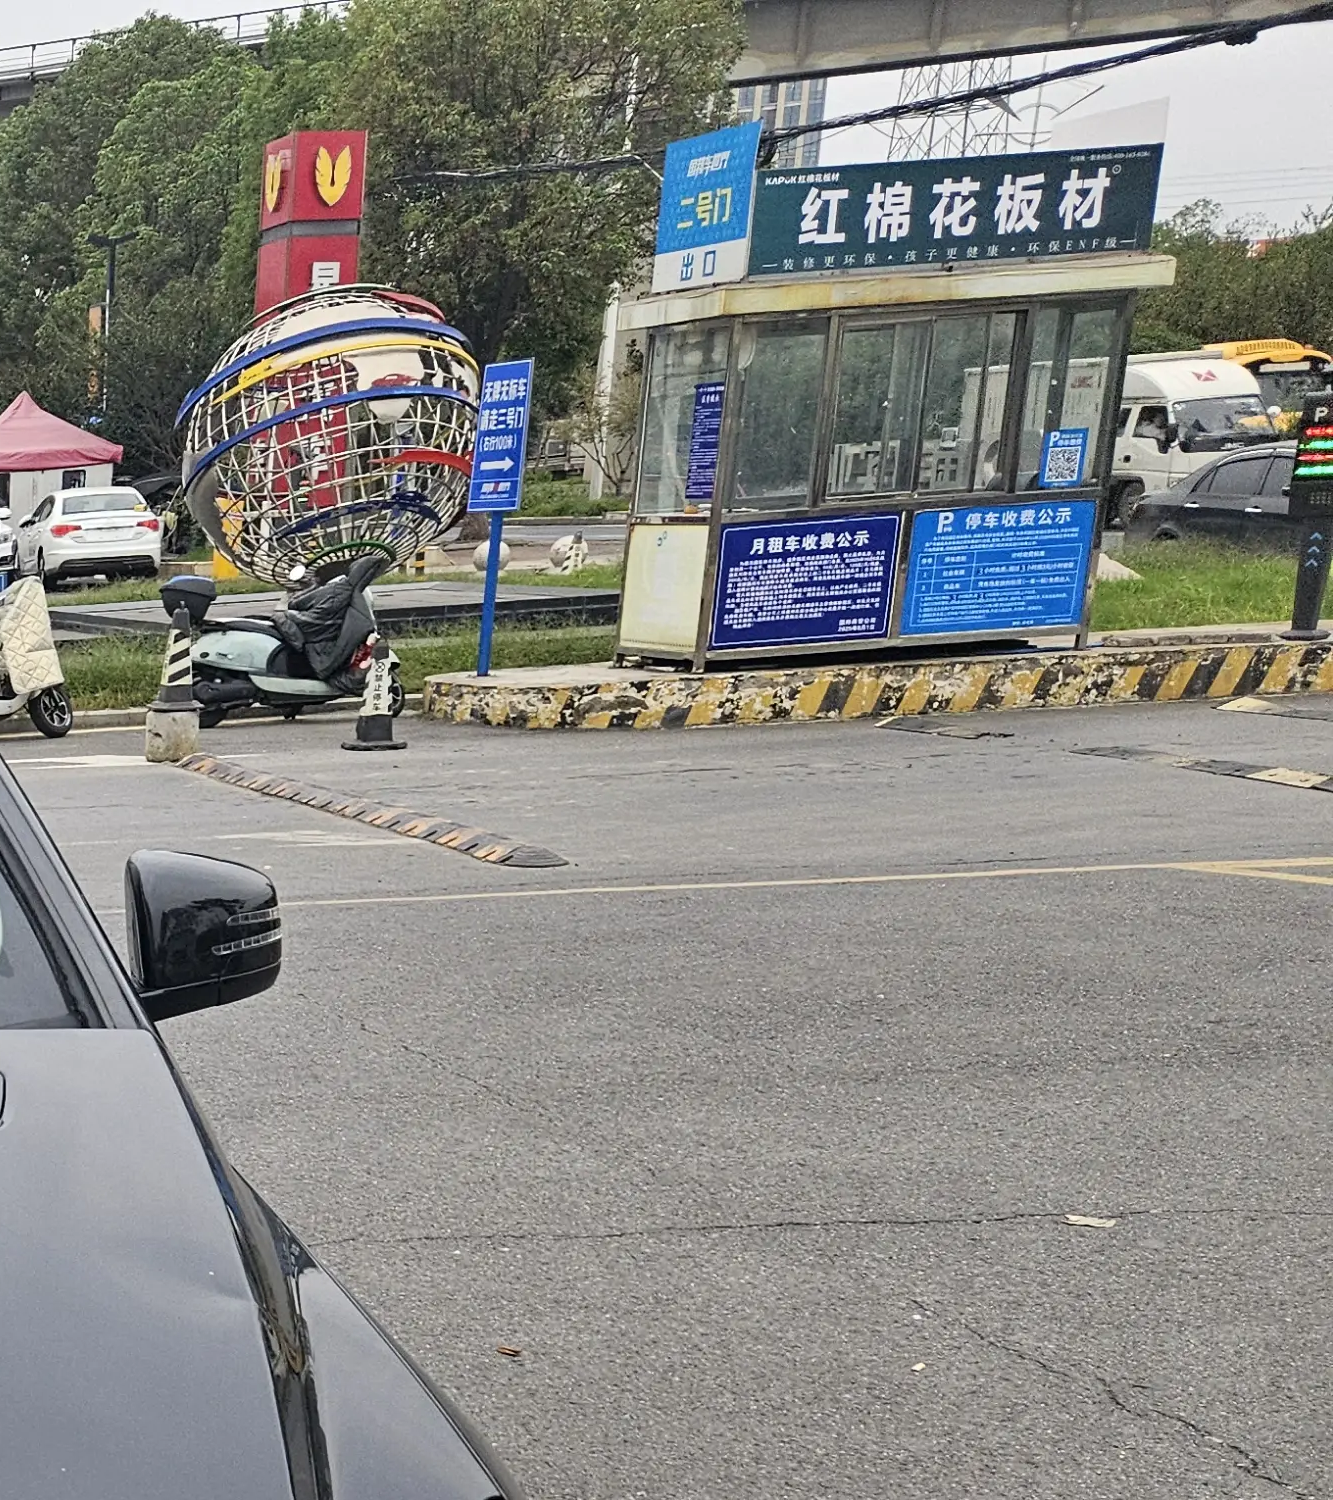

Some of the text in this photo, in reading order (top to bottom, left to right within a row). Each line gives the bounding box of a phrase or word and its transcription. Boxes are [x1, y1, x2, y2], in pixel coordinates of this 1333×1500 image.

[798, 172, 839, 184] 红棉花板材
[677, 187, 732, 229] 二号门
[798, 167, 1110, 245] 红棉花板材
[680, 250, 716, 281] 出口
[480, 406, 524, 431] 请走三号门
[1315, 407, 1329, 422] P
[965, 507, 1072, 530] 停车收费公示
[750, 530, 870, 555] 月租车收费公示
[373, 674, 383, 711] 禁止停车
